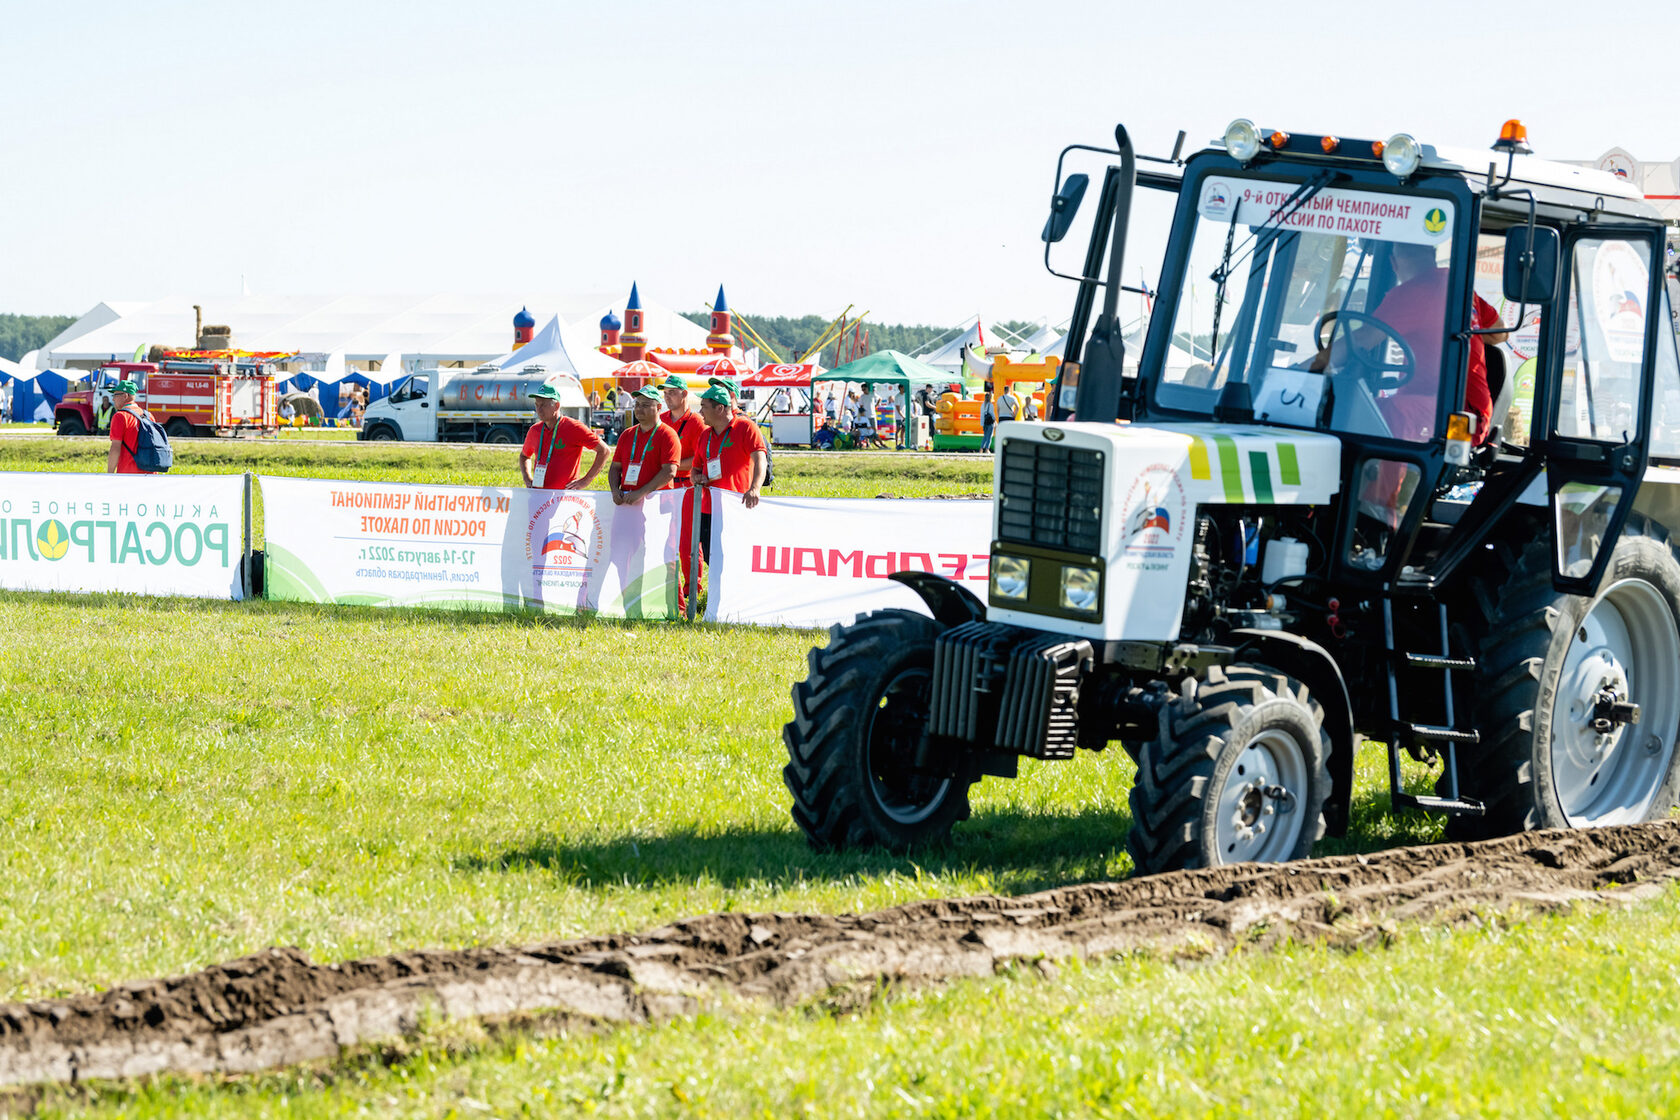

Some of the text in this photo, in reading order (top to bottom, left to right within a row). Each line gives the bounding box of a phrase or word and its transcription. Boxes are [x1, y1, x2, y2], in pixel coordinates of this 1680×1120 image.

[1243, 188, 1263, 204] 9-й
[1265, 191, 1334, 211] ОТКТЫЙ
[1337, 198, 1411, 220] ЧЕМПИОНАТ
[1318, 215, 1335, 230] ПО
[1337, 216, 1382, 234] ПАХОТЕ
[459, 384, 518, 404] ВОДА
